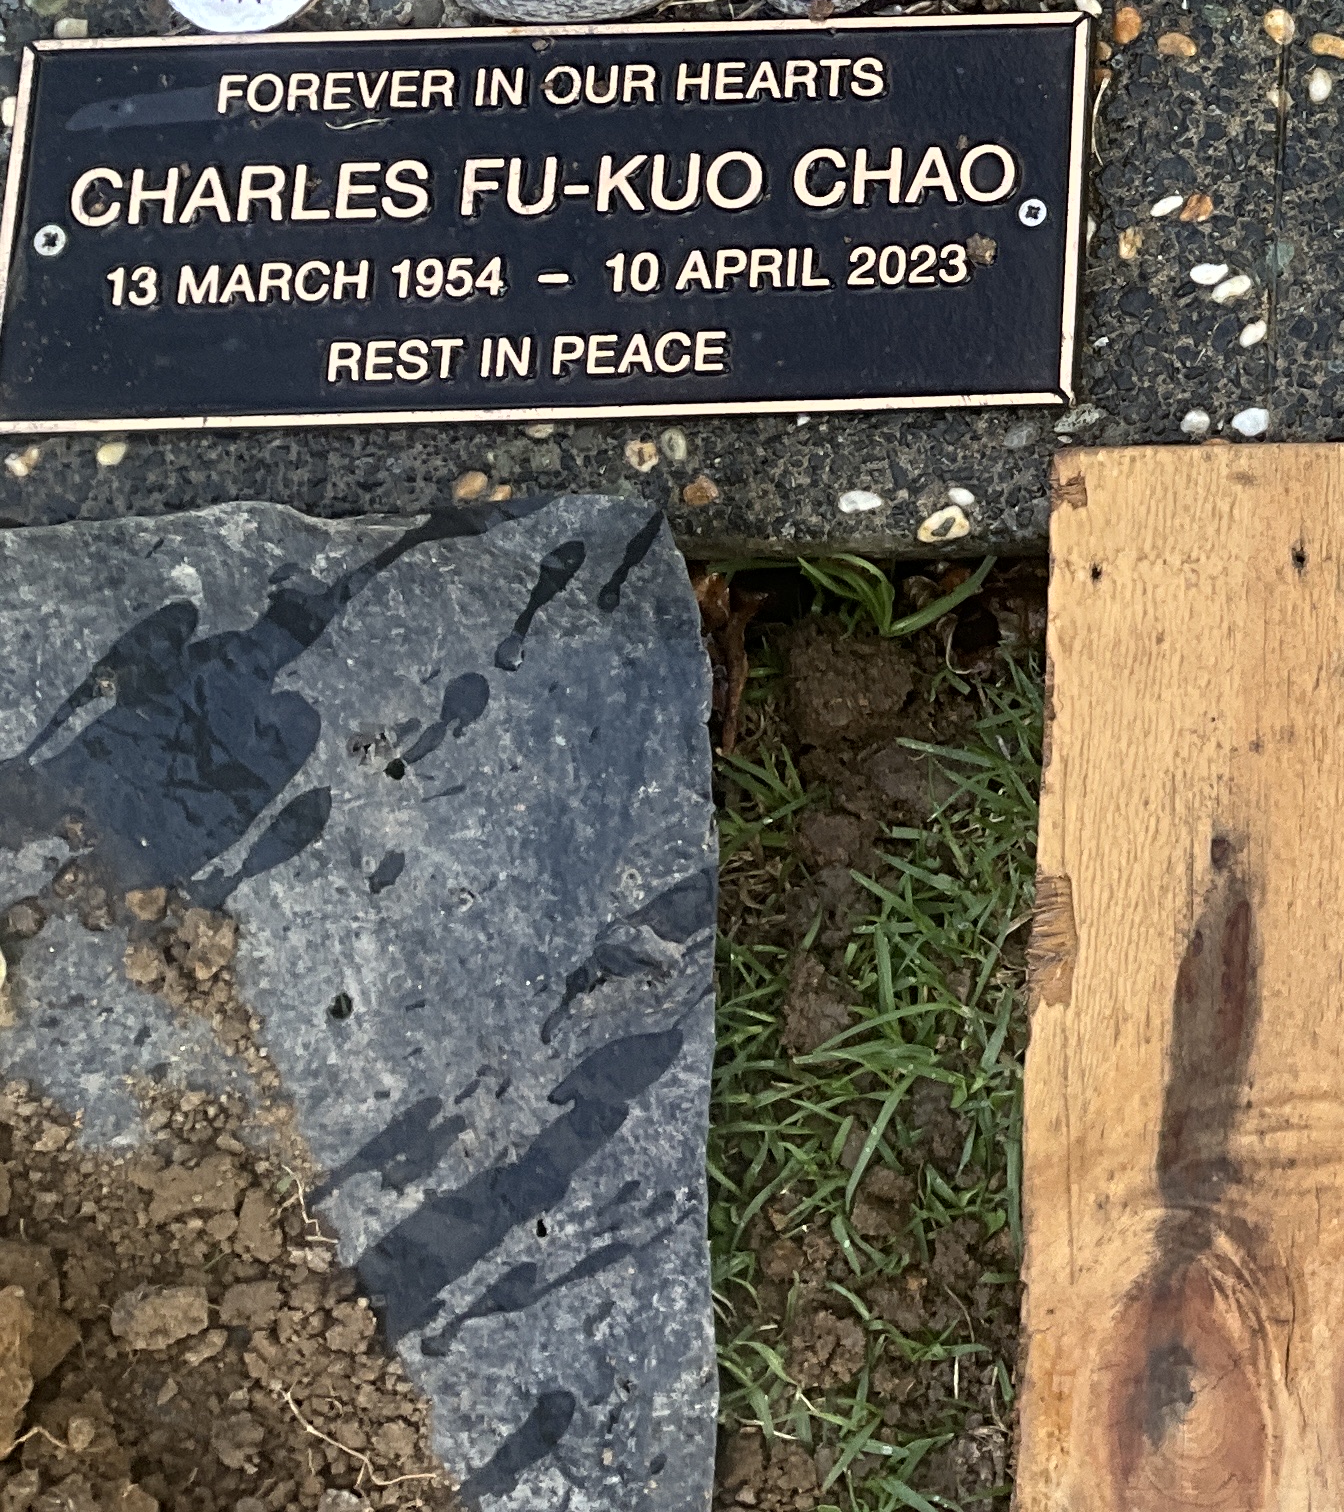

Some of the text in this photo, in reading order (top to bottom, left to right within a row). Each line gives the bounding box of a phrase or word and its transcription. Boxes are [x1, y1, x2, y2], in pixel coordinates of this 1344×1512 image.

[216, 56, 885, 115] FOREVER IN OUR HEARTS
[70, 143, 1016, 228] CHARLES FU-KUO CHAO
[105, 265, 158, 307] 13
[176, 258, 370, 306] MARCH
[390, 255, 505, 300] 1954
[604, 251, 660, 293] 10
[674, 246, 831, 291] APRIL
[846, 242, 968, 286] 2023
[326, 330, 728, 383] REST IN PEACE
